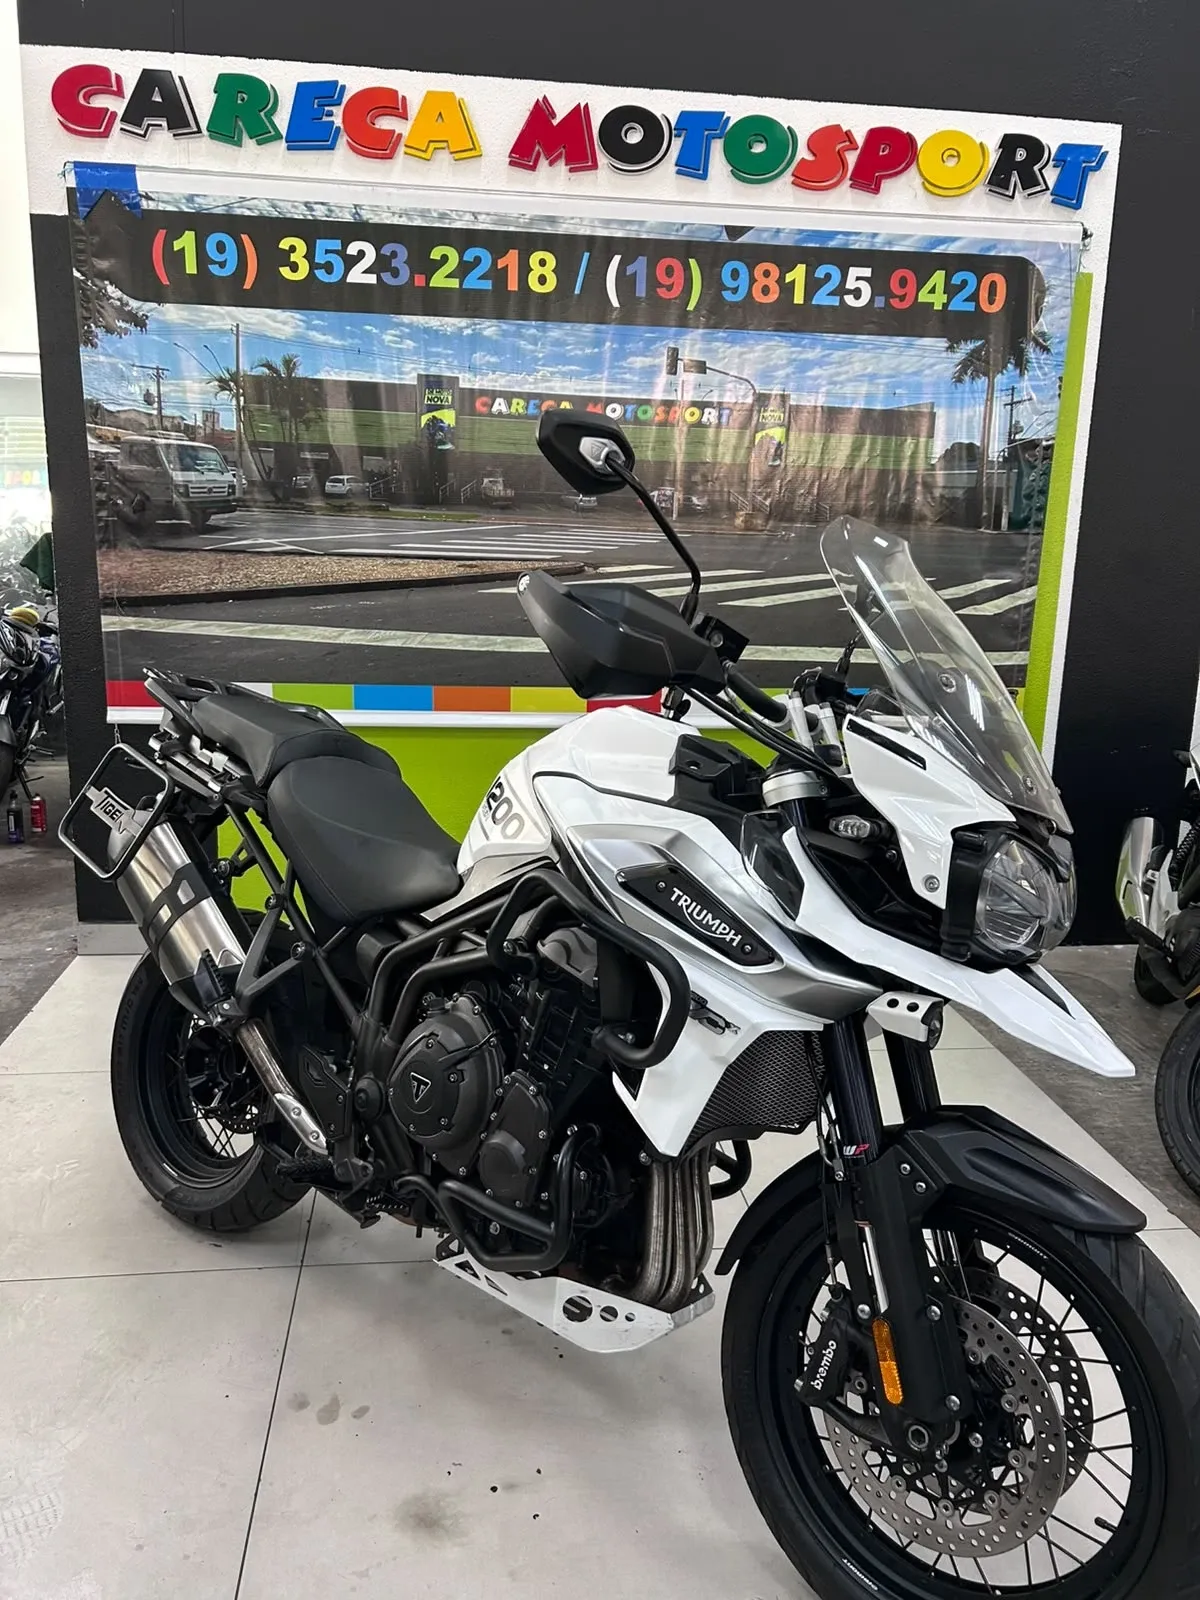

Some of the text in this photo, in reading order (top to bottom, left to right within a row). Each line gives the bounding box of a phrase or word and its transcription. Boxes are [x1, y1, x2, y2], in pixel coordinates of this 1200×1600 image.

[51, 64, 1109, 211] CARECA MOTOSPORT
[152, 229, 1007, 314] (19) 3523.2218 / (19) 98125.9420
[426, 395, 450, 404] NOVA
[670, 887, 742, 947] TRIUMPH
[843, 1143, 870, 1156] WP
[810, 1340, 837, 1391] brembo
